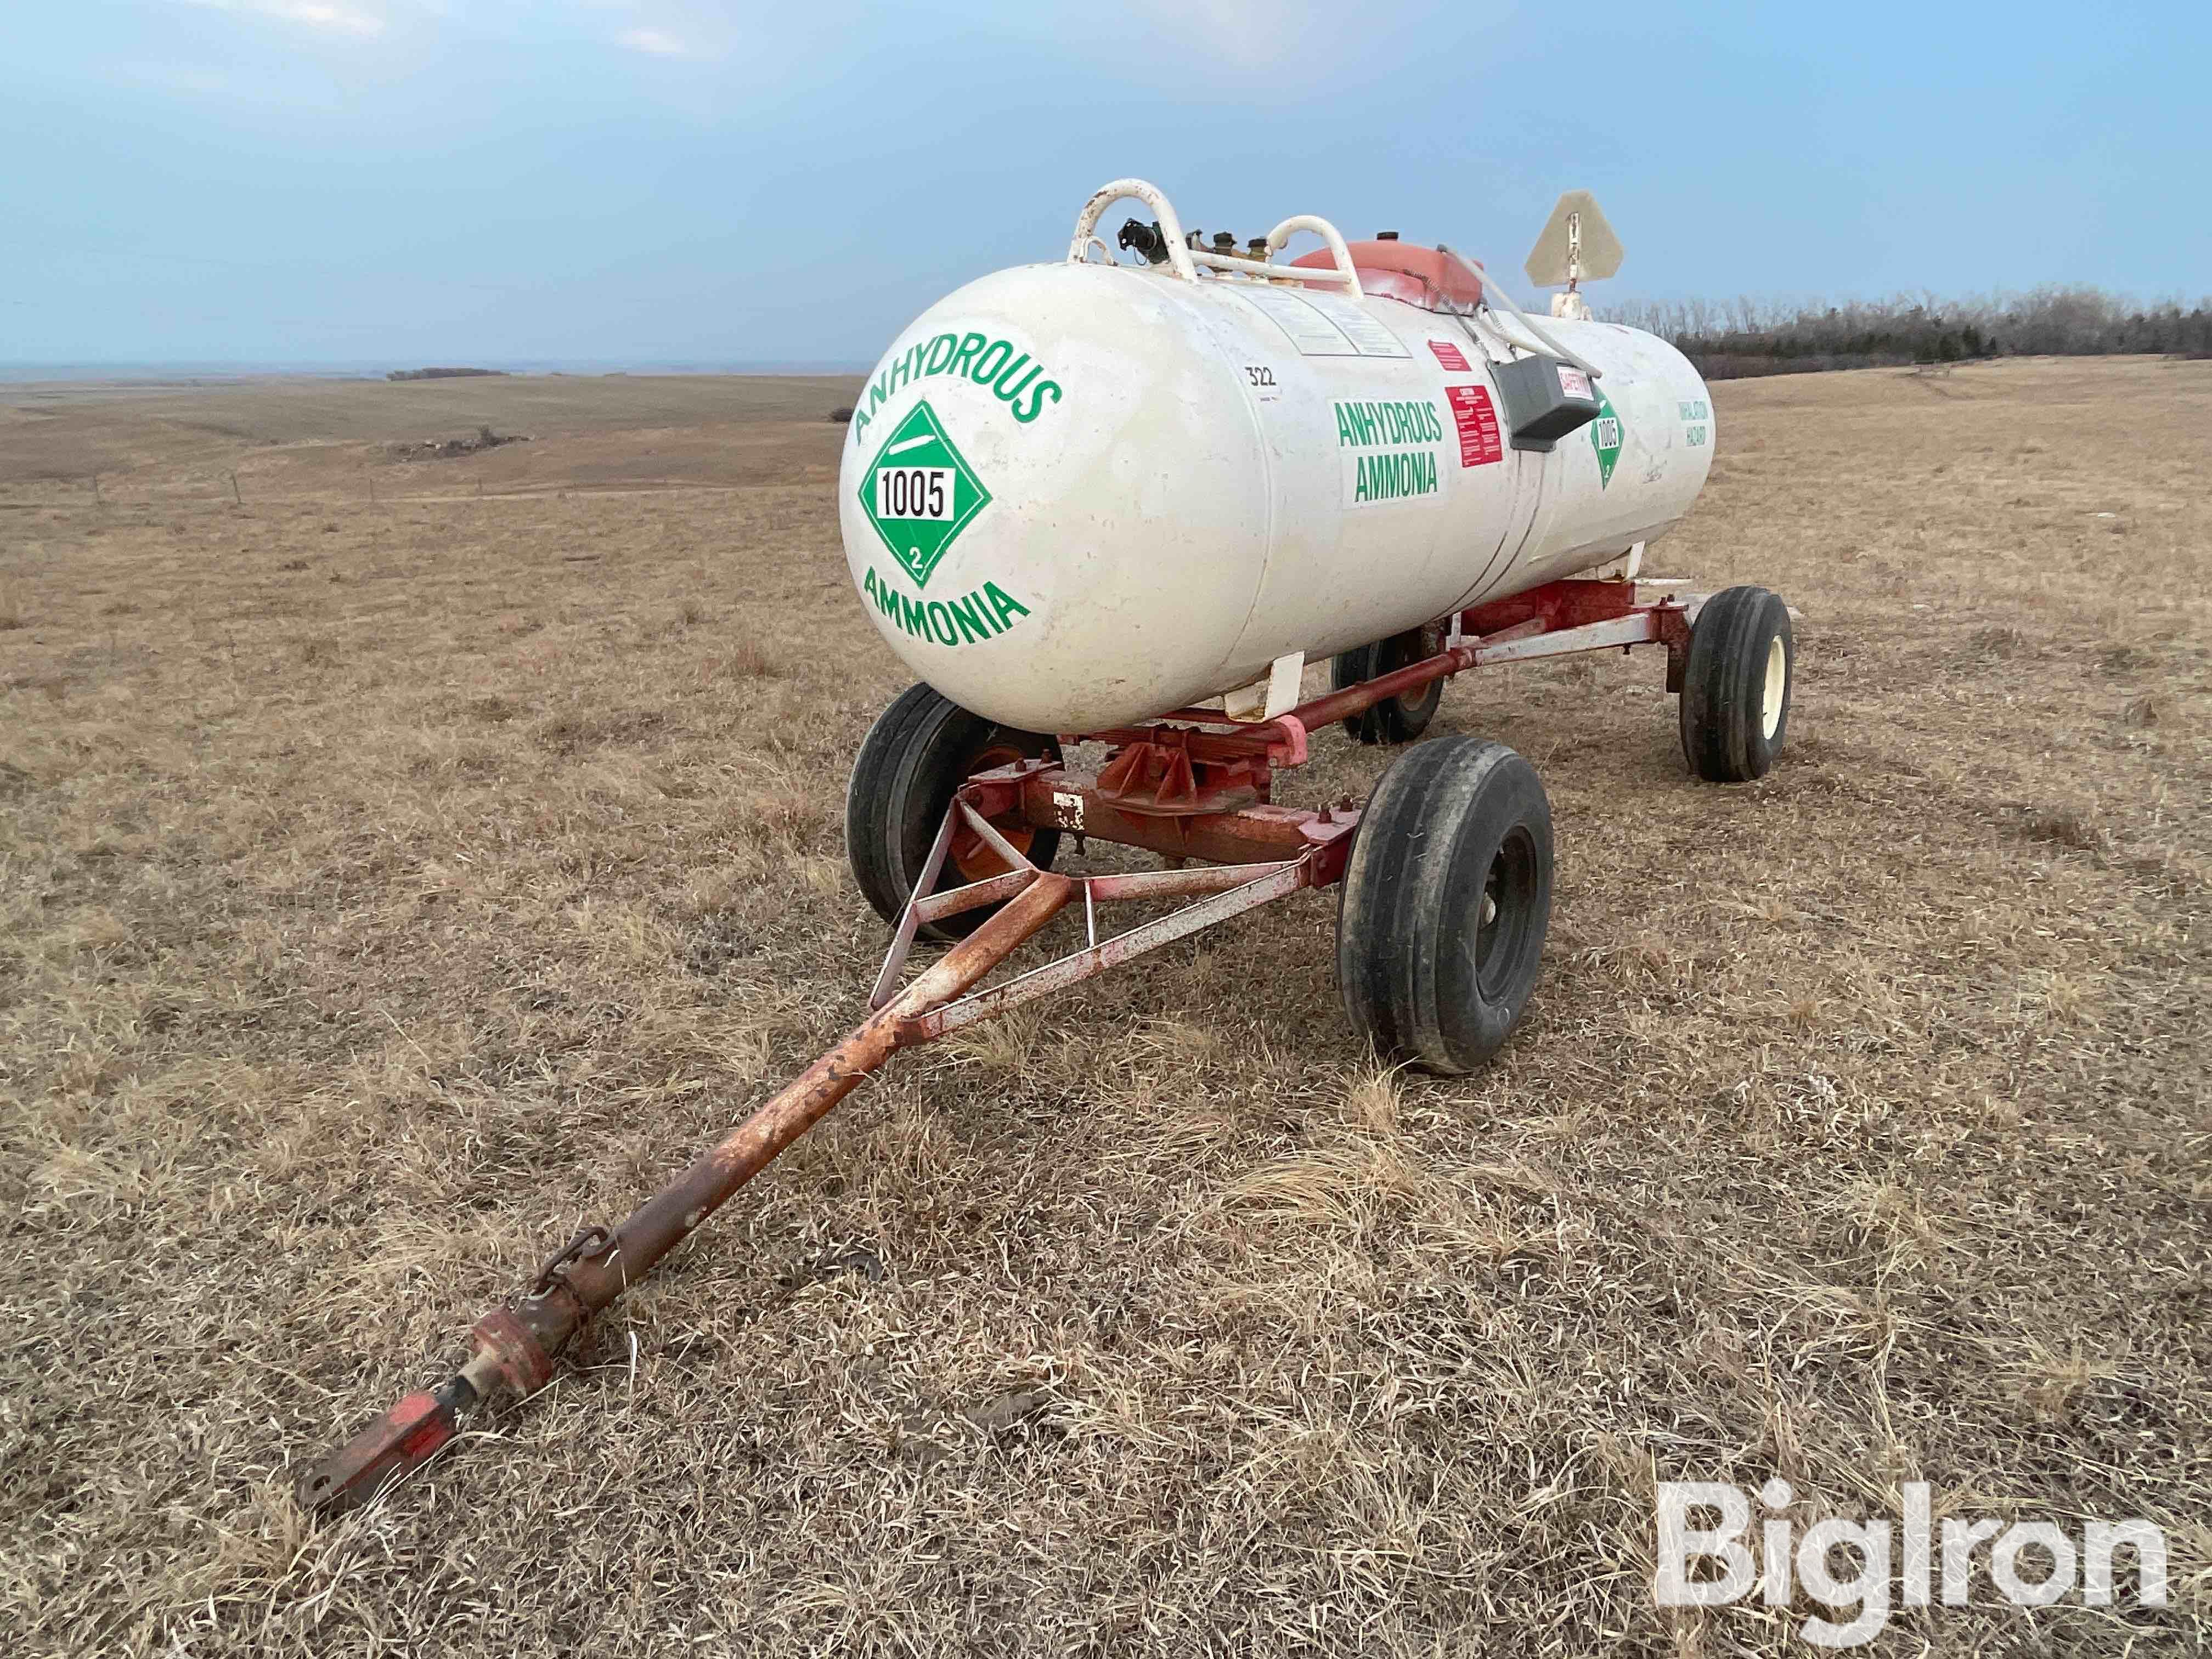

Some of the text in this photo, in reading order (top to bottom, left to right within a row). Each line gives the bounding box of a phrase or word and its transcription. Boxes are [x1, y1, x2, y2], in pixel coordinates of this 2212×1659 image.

[854, 332, 1063, 447] ANHYDROUS
[1245, 366, 1277, 386] 322
[1334, 402, 1442, 447] ANHYDROUS
[1598, 419, 1617, 447] 1005
[882, 470, 944, 517] 1005
[1355, 452, 1437, 501] AMMONIA
[909, 548, 923, 568] 2
[864, 566, 1031, 646] AMMONIA
